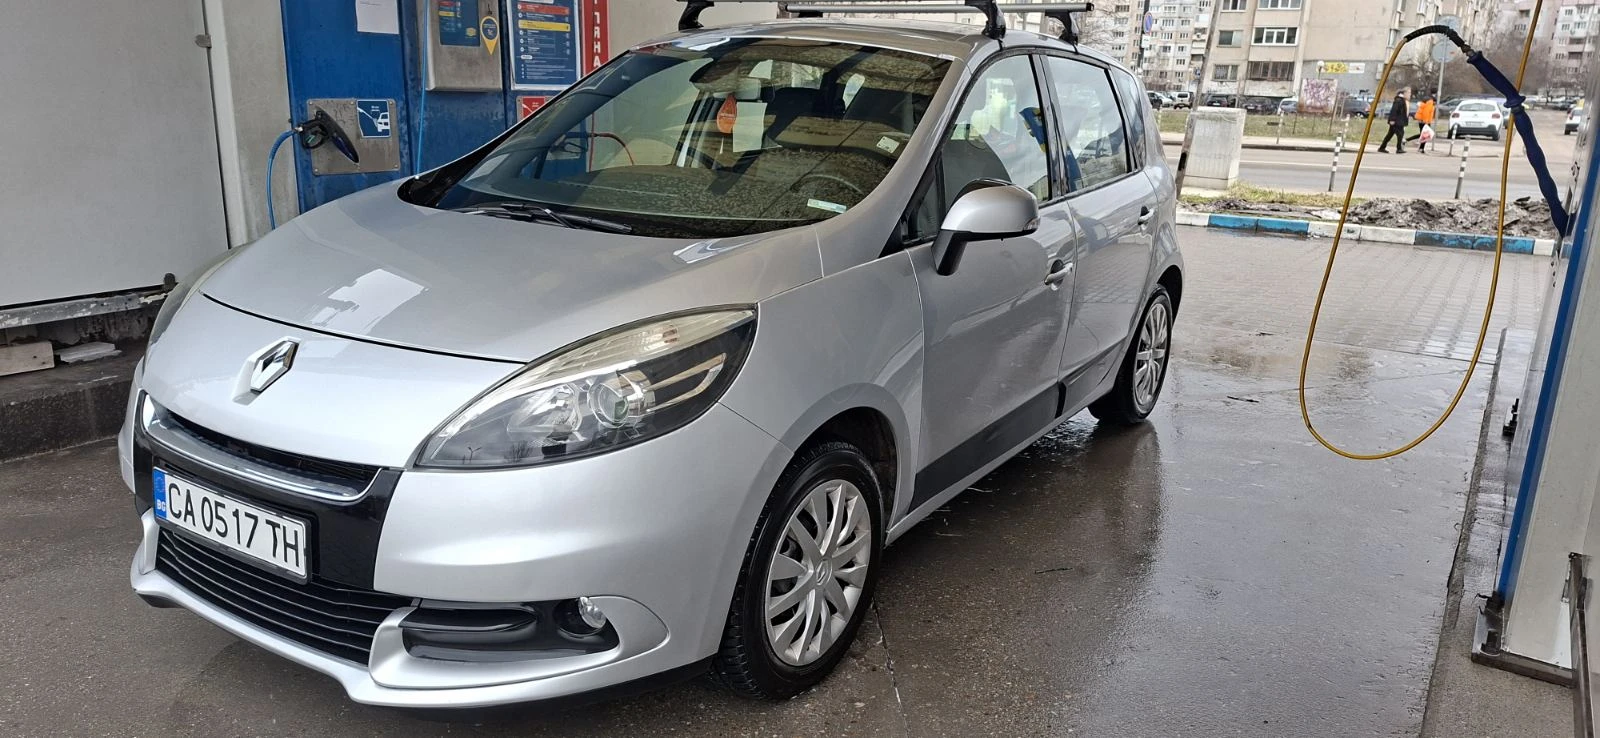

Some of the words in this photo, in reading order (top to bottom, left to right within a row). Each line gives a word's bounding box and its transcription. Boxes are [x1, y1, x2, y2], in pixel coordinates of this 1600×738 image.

[156, 500, 166, 511] BG
[168, 483, 196, 527] CA
[201, 496, 259, 549] 0517
[265, 518, 300, 567] TH
